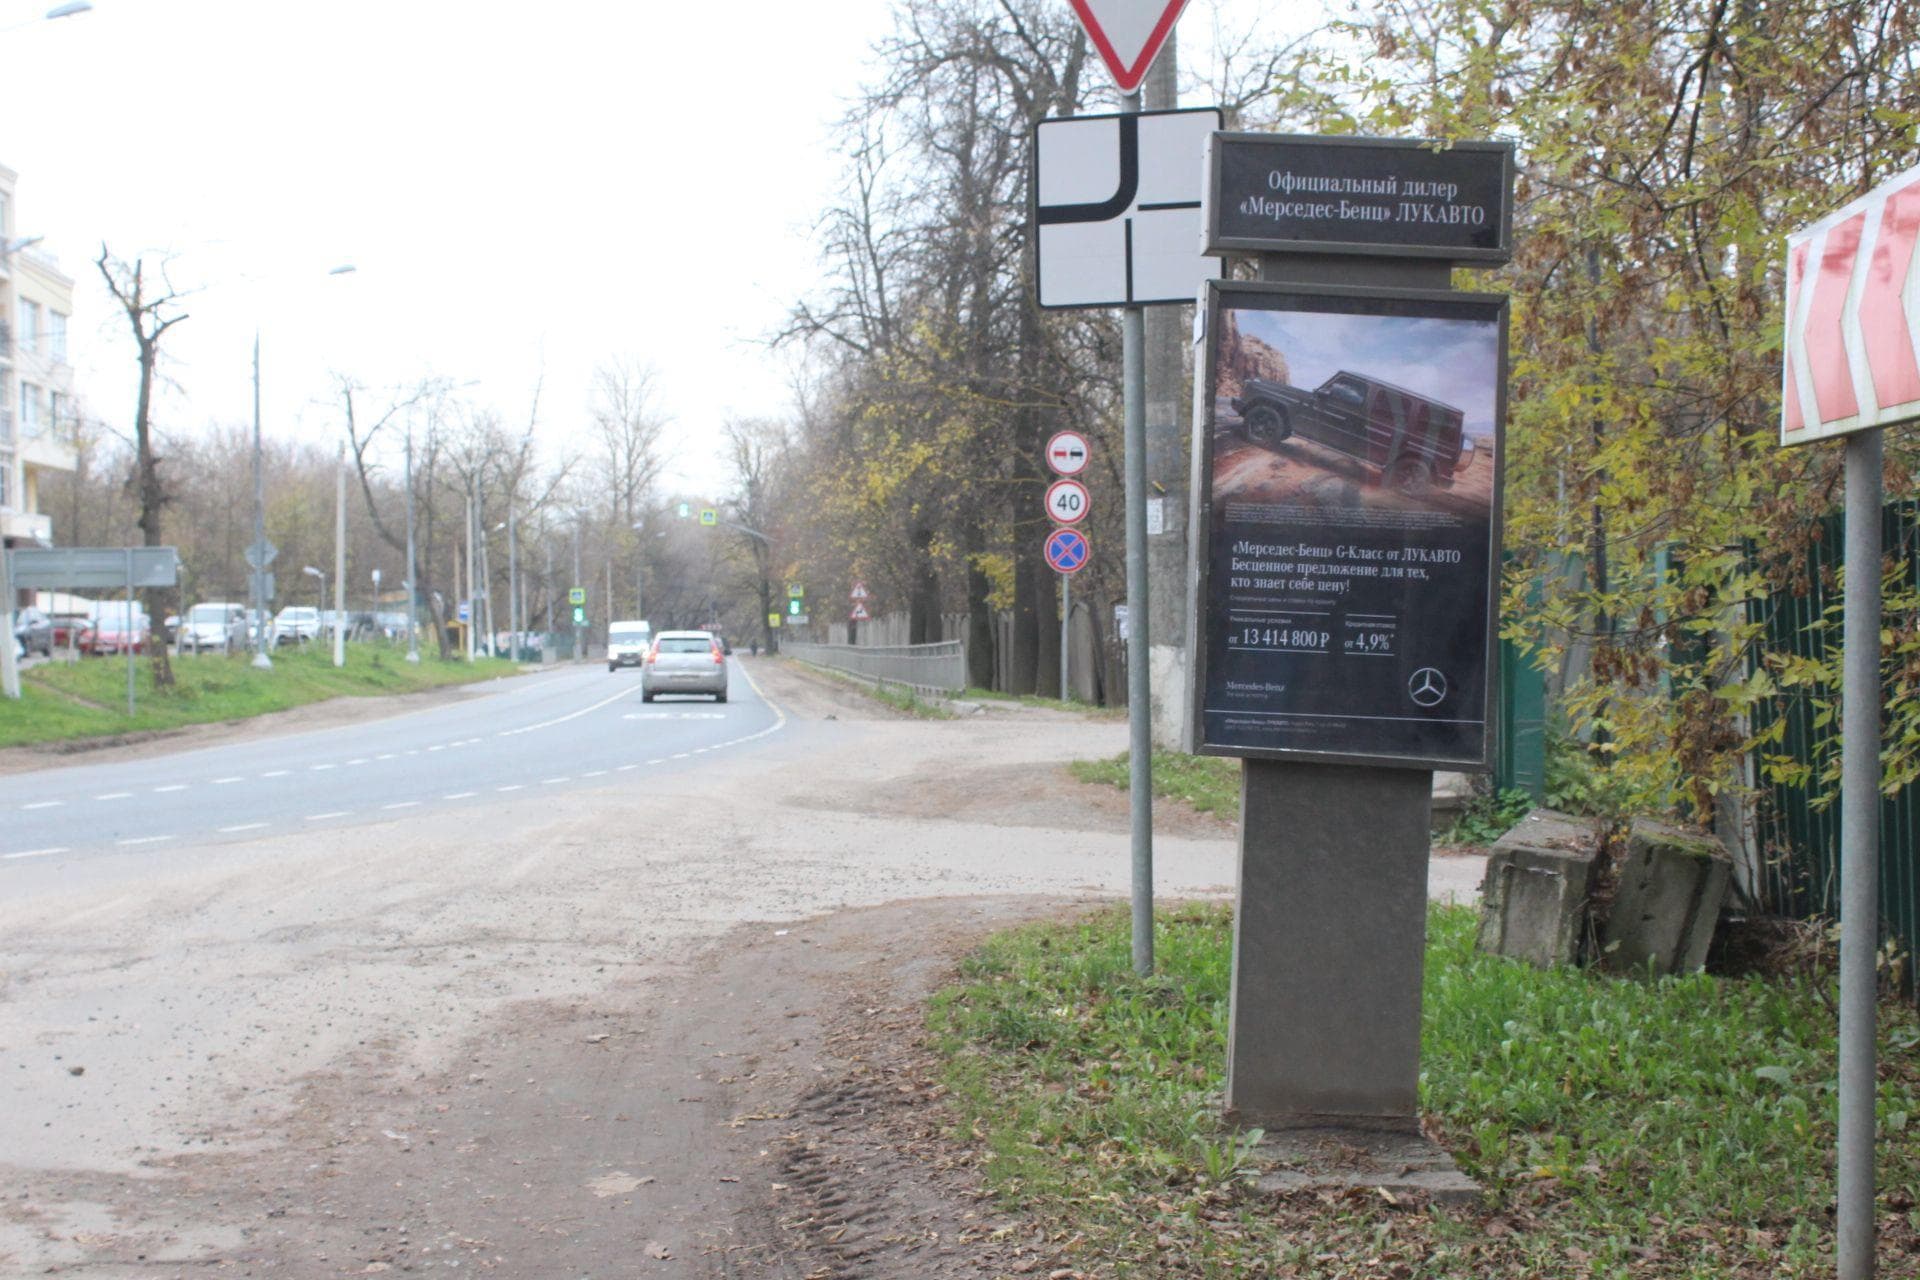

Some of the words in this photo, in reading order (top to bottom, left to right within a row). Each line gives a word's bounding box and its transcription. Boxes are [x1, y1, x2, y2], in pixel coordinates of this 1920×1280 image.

[1268, 170, 1397, 194] Официальный
[1402, 180, 1458, 201] дилер
[1240, 196, 1391, 221] «Мерседес-Бенц»
[1396, 203, 1485, 225] ЛУКАВТО
[1057, 494, 1080, 511] 40
[1232, 541, 1333, 558] «Мерседес-Бенц»
[1336, 545, 1383, 560] G-Класс
[1386, 550, 1399, 560] от
[1402, 548, 1461, 564] ЛУКАВТО
[1231, 557, 1294, 573] Бесценное
[1297, 563, 1378, 577] предложение
[1381, 567, 1403, 579] для
[1406, 568, 1429, 580] тех,
[1231, 577, 1250, 588] кто
[1254, 578, 1285, 590] знает
[1288, 577, 1314, 591] себе
[1317, 579, 1350, 595] цену!
[1228, 636, 1238, 644] от
[1344, 640, 1354, 649] от
